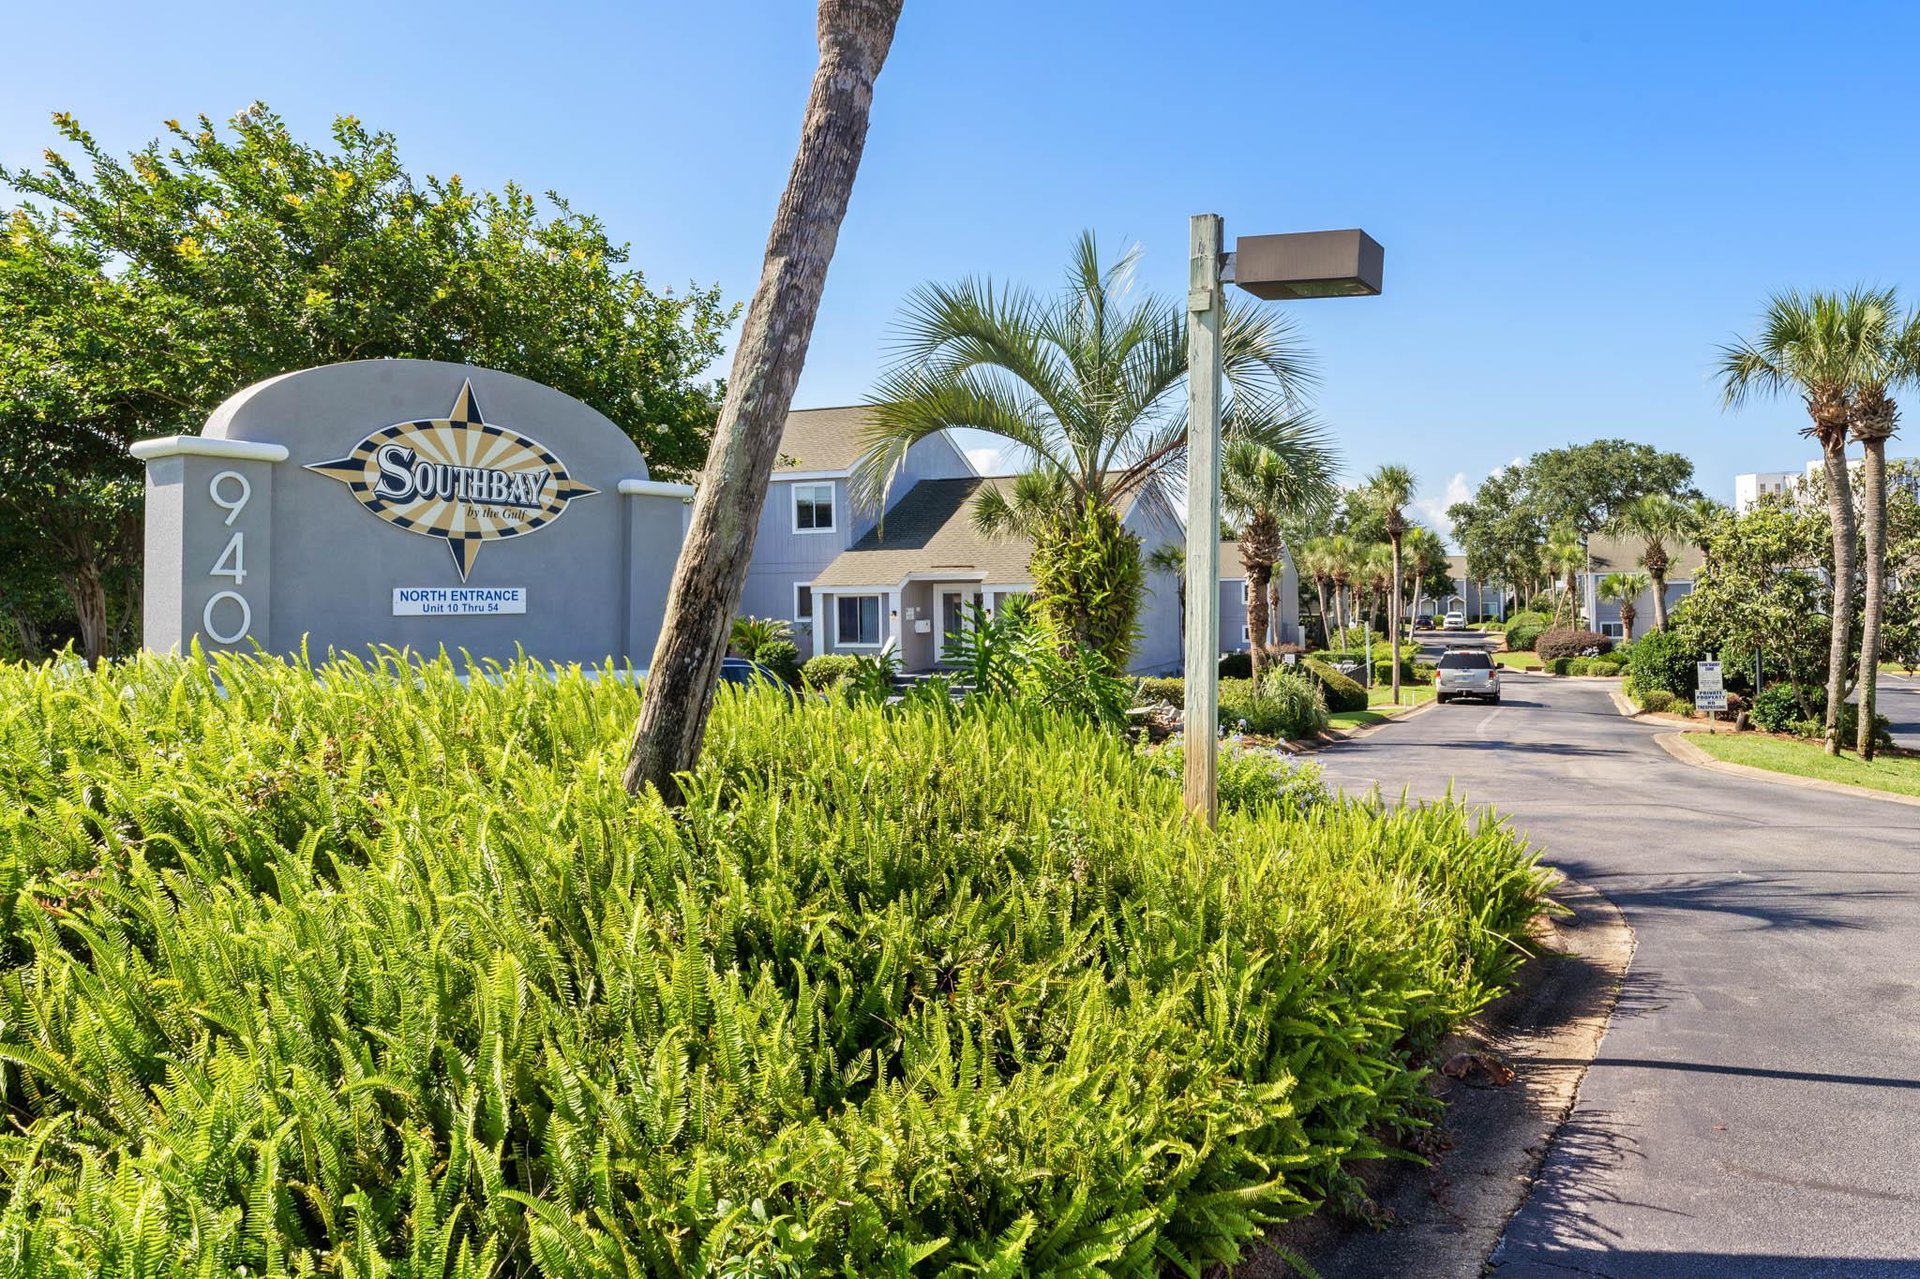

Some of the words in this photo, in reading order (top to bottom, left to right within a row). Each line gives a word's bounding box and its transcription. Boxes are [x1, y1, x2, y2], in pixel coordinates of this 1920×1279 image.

[467, 506, 480, 521] by
[483, 507, 500, 520] the
[502, 509, 528, 522] Gulf
[400, 590, 447, 601] NORTH
[451, 590, 519, 601] ENTRANCE
[423, 604, 444, 613] Unit
[447, 604, 459, 613] 10
[462, 603, 485, 613] Thru
[487, 603, 499, 612] 54
